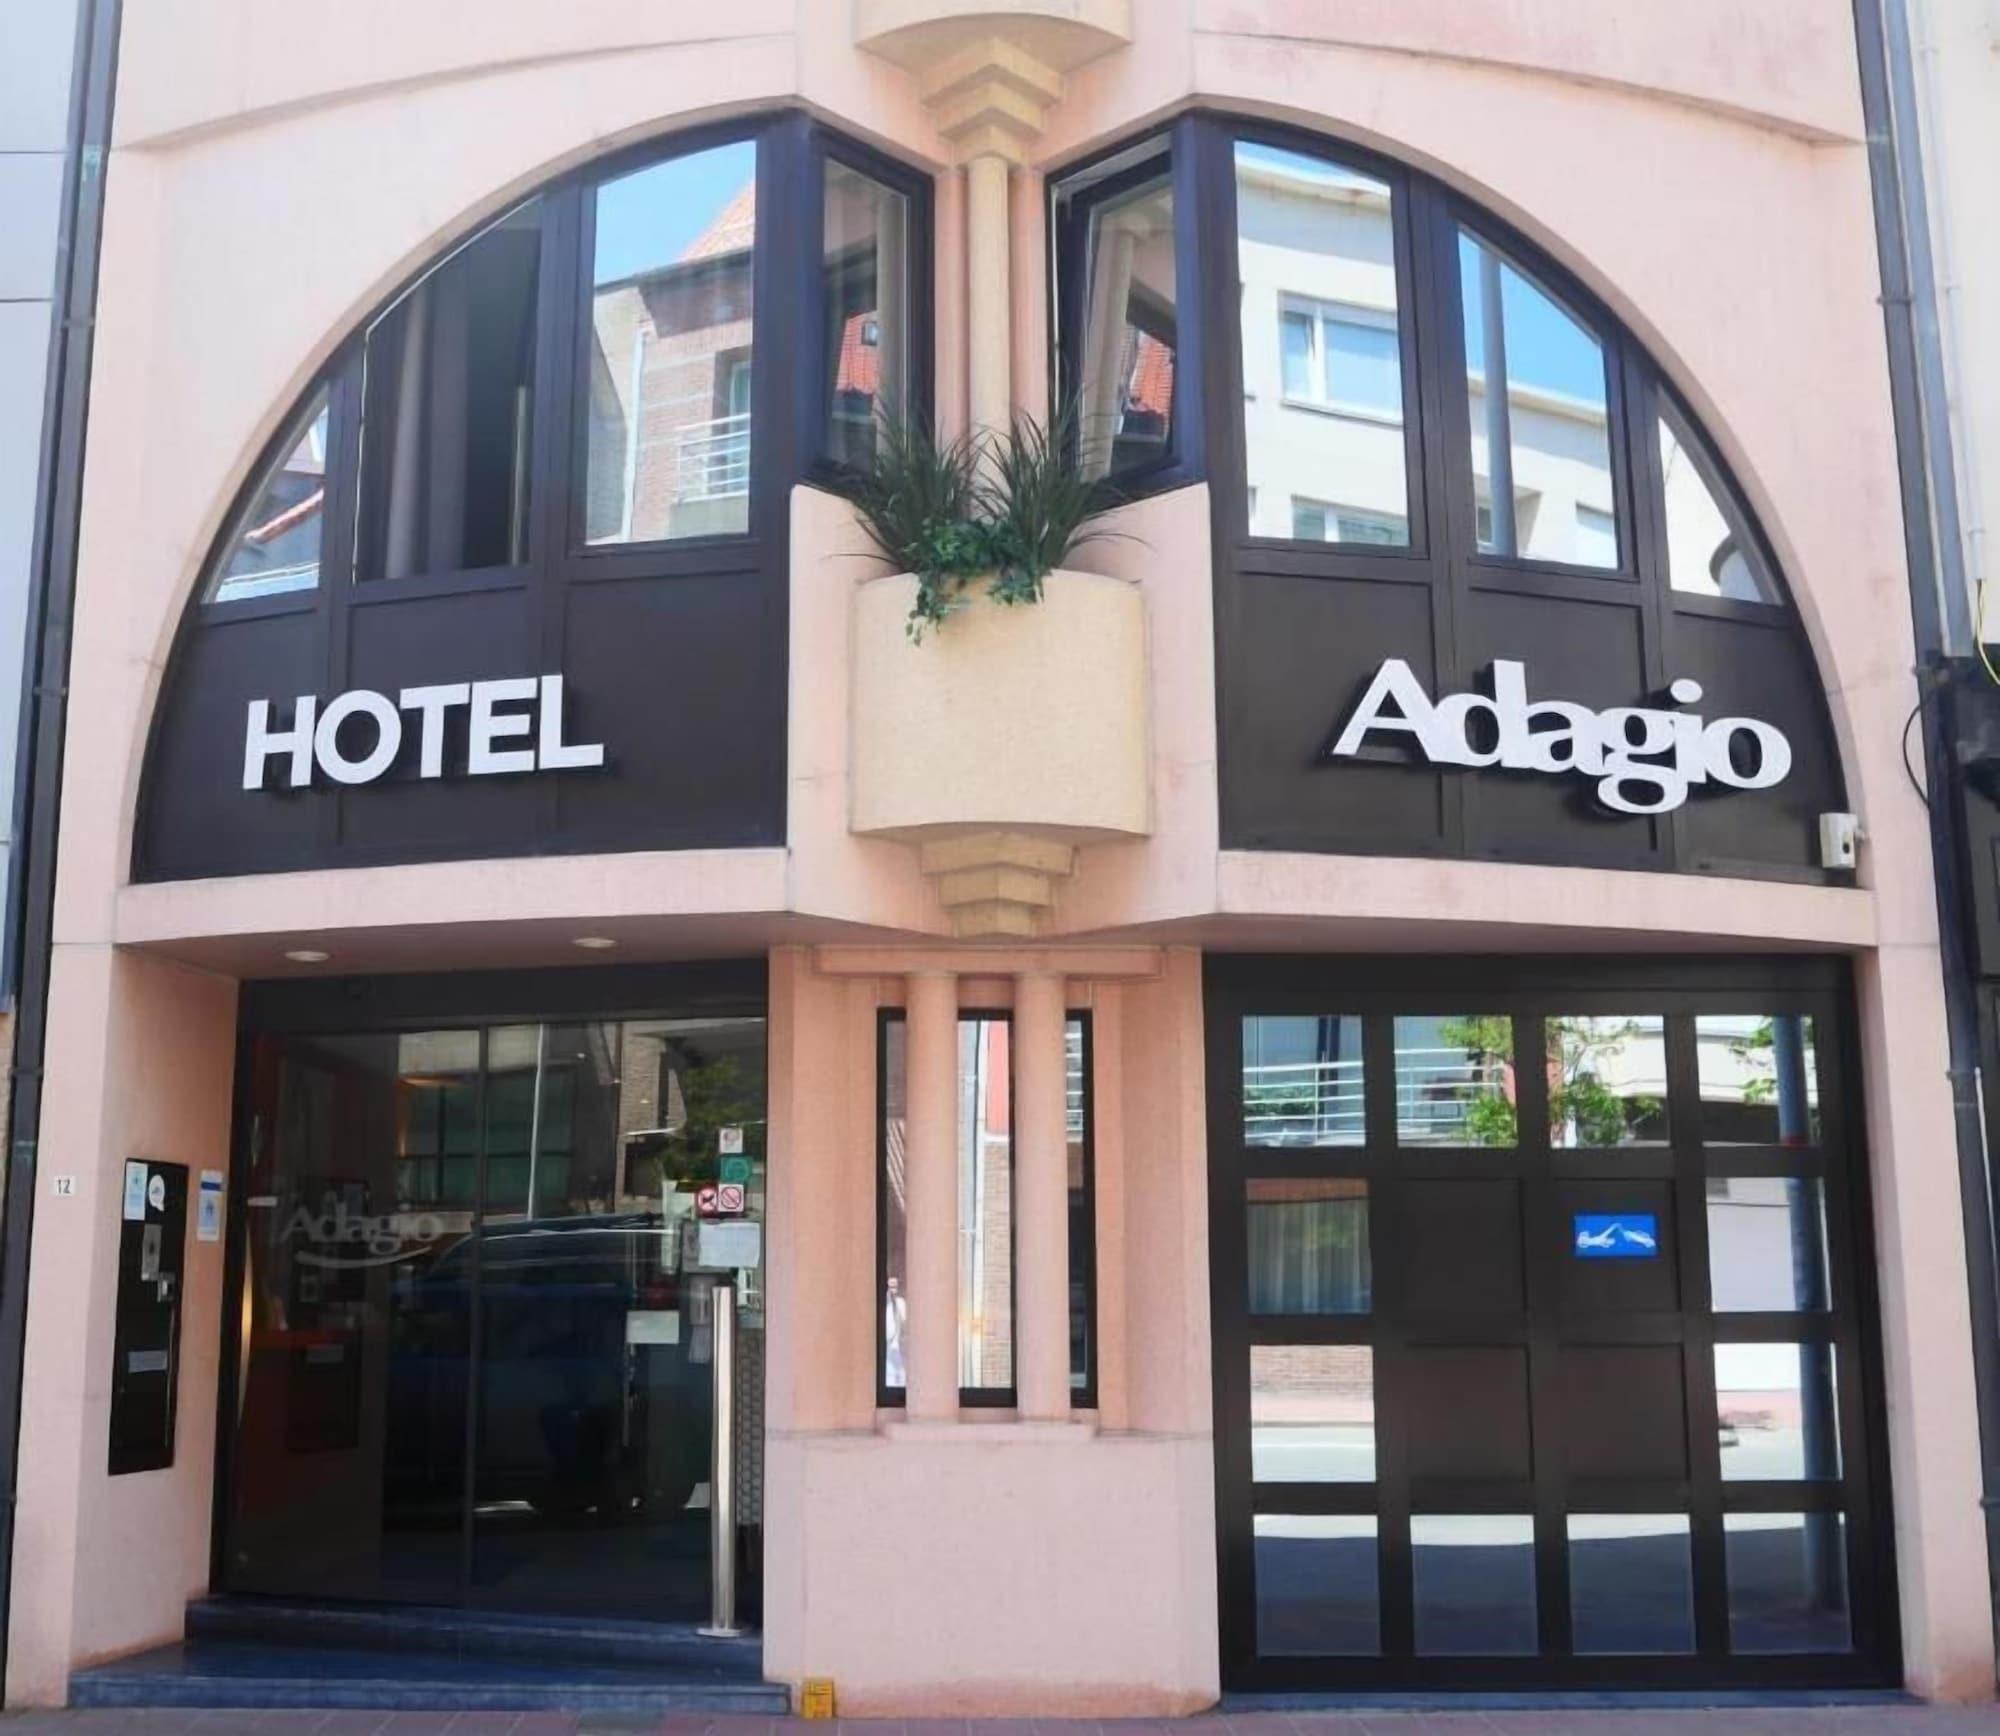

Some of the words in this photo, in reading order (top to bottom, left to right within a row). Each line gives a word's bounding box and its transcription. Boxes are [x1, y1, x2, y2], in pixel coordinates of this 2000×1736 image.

[243, 674, 604, 790] HOTEL
[1332, 658, 1793, 814] Adagio
[57, 1178, 72, 1194] 12
[279, 1201, 443, 1254] Adagio
